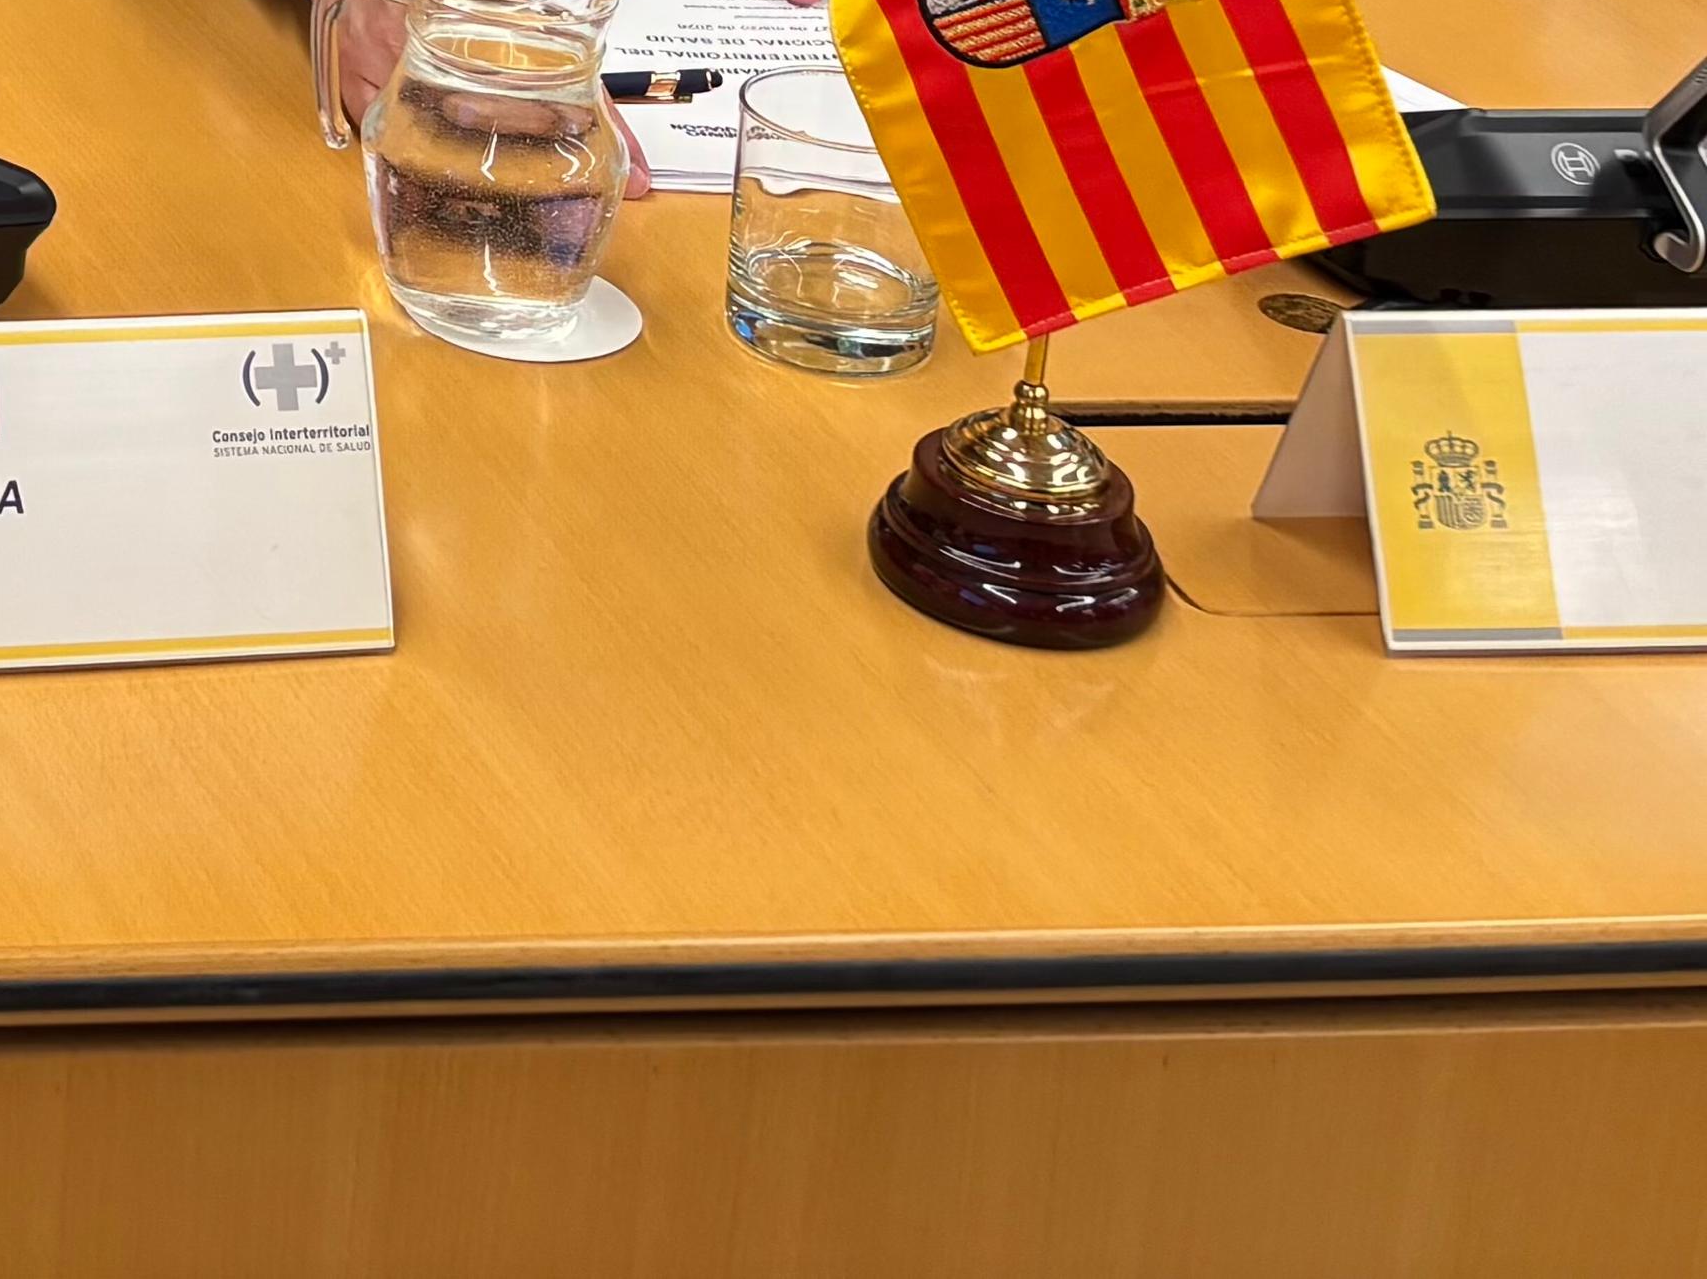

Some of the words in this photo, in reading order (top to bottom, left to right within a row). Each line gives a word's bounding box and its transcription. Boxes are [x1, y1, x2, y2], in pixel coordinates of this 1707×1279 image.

[750, 37, 834, 47] CIONAL
[659, 48, 838, 61] TERTERRITORIAL
[212, 428, 266, 445] Consejo
[269, 424, 370, 441] Interterritorial
[213, 445, 259, 458] SISTEMA
[262, 443, 316, 455] NACIONAL
[319, 442, 333, 453] DE
[337, 440, 371, 453] SALUD
